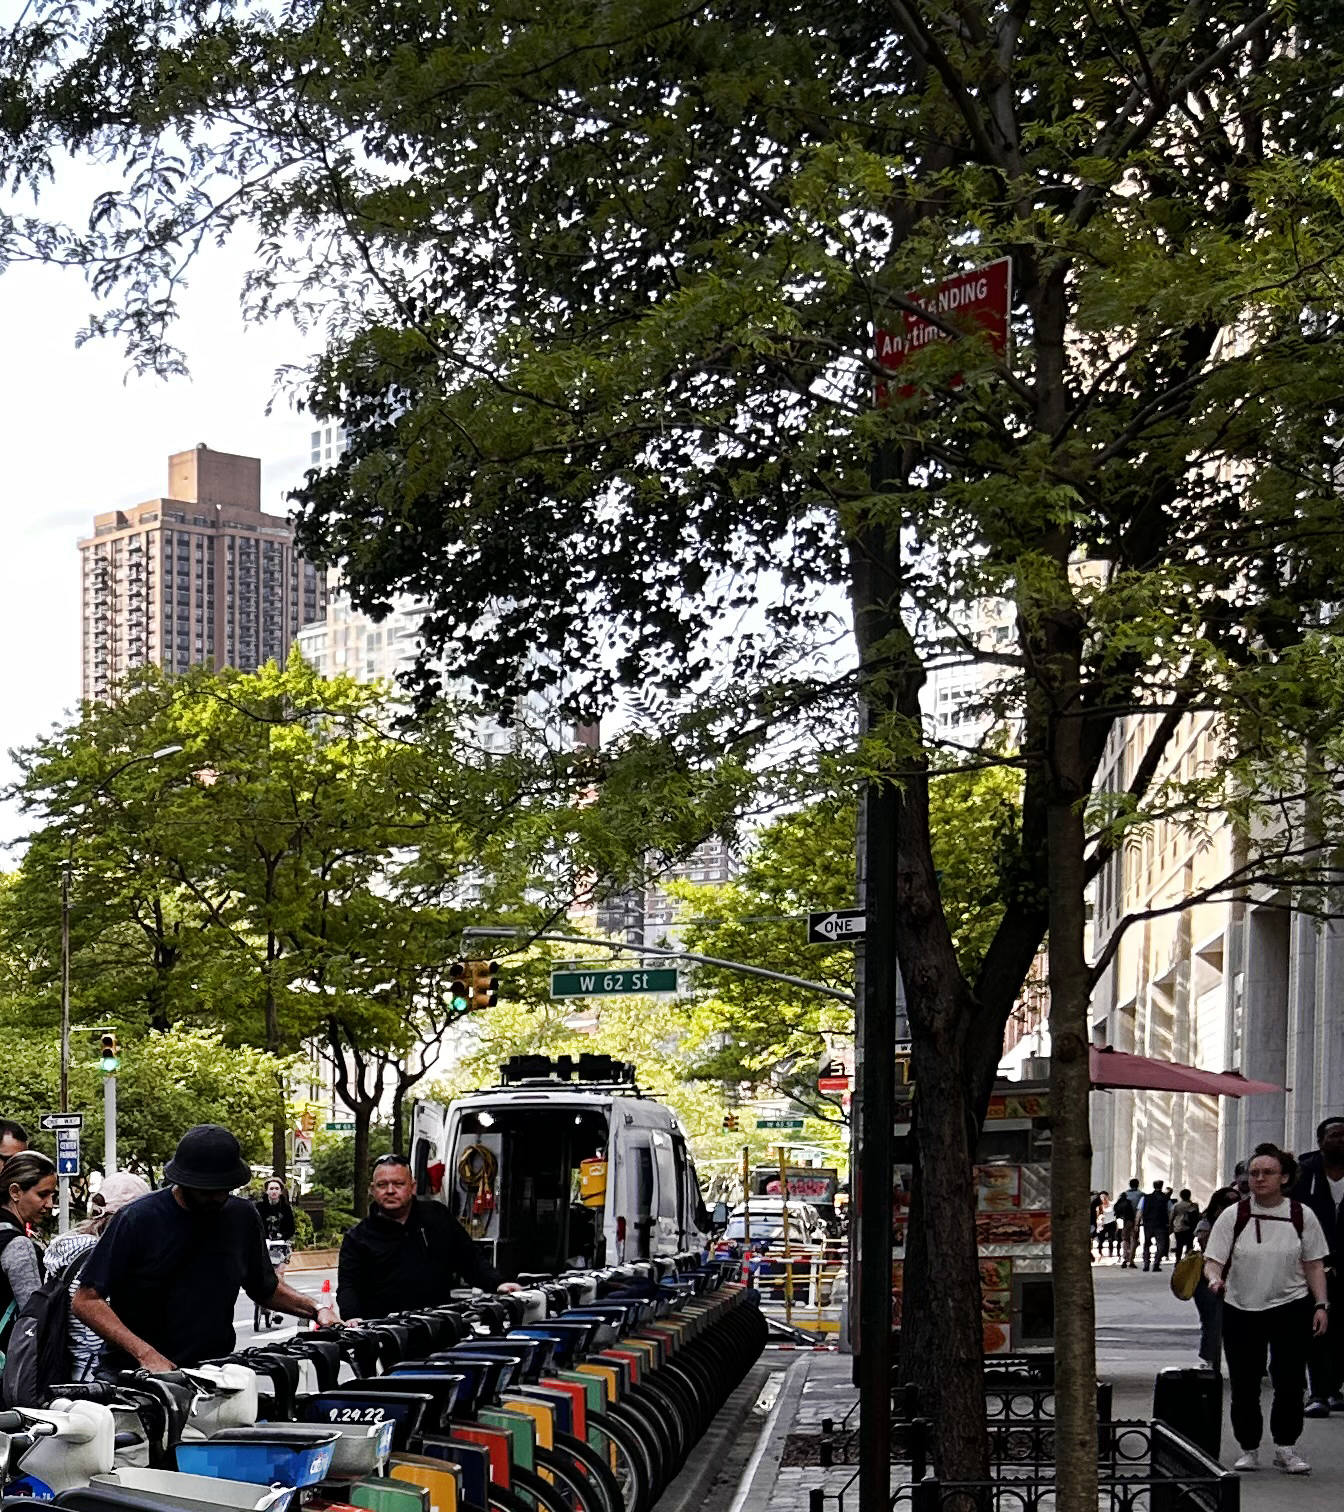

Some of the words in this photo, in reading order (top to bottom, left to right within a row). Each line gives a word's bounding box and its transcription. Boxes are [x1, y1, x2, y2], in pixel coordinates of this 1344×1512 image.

[824, 919, 853, 933] ONE
[580, 976, 595, 992] W
[603, 974, 624, 991] 62
[631, 973, 649, 990] St
